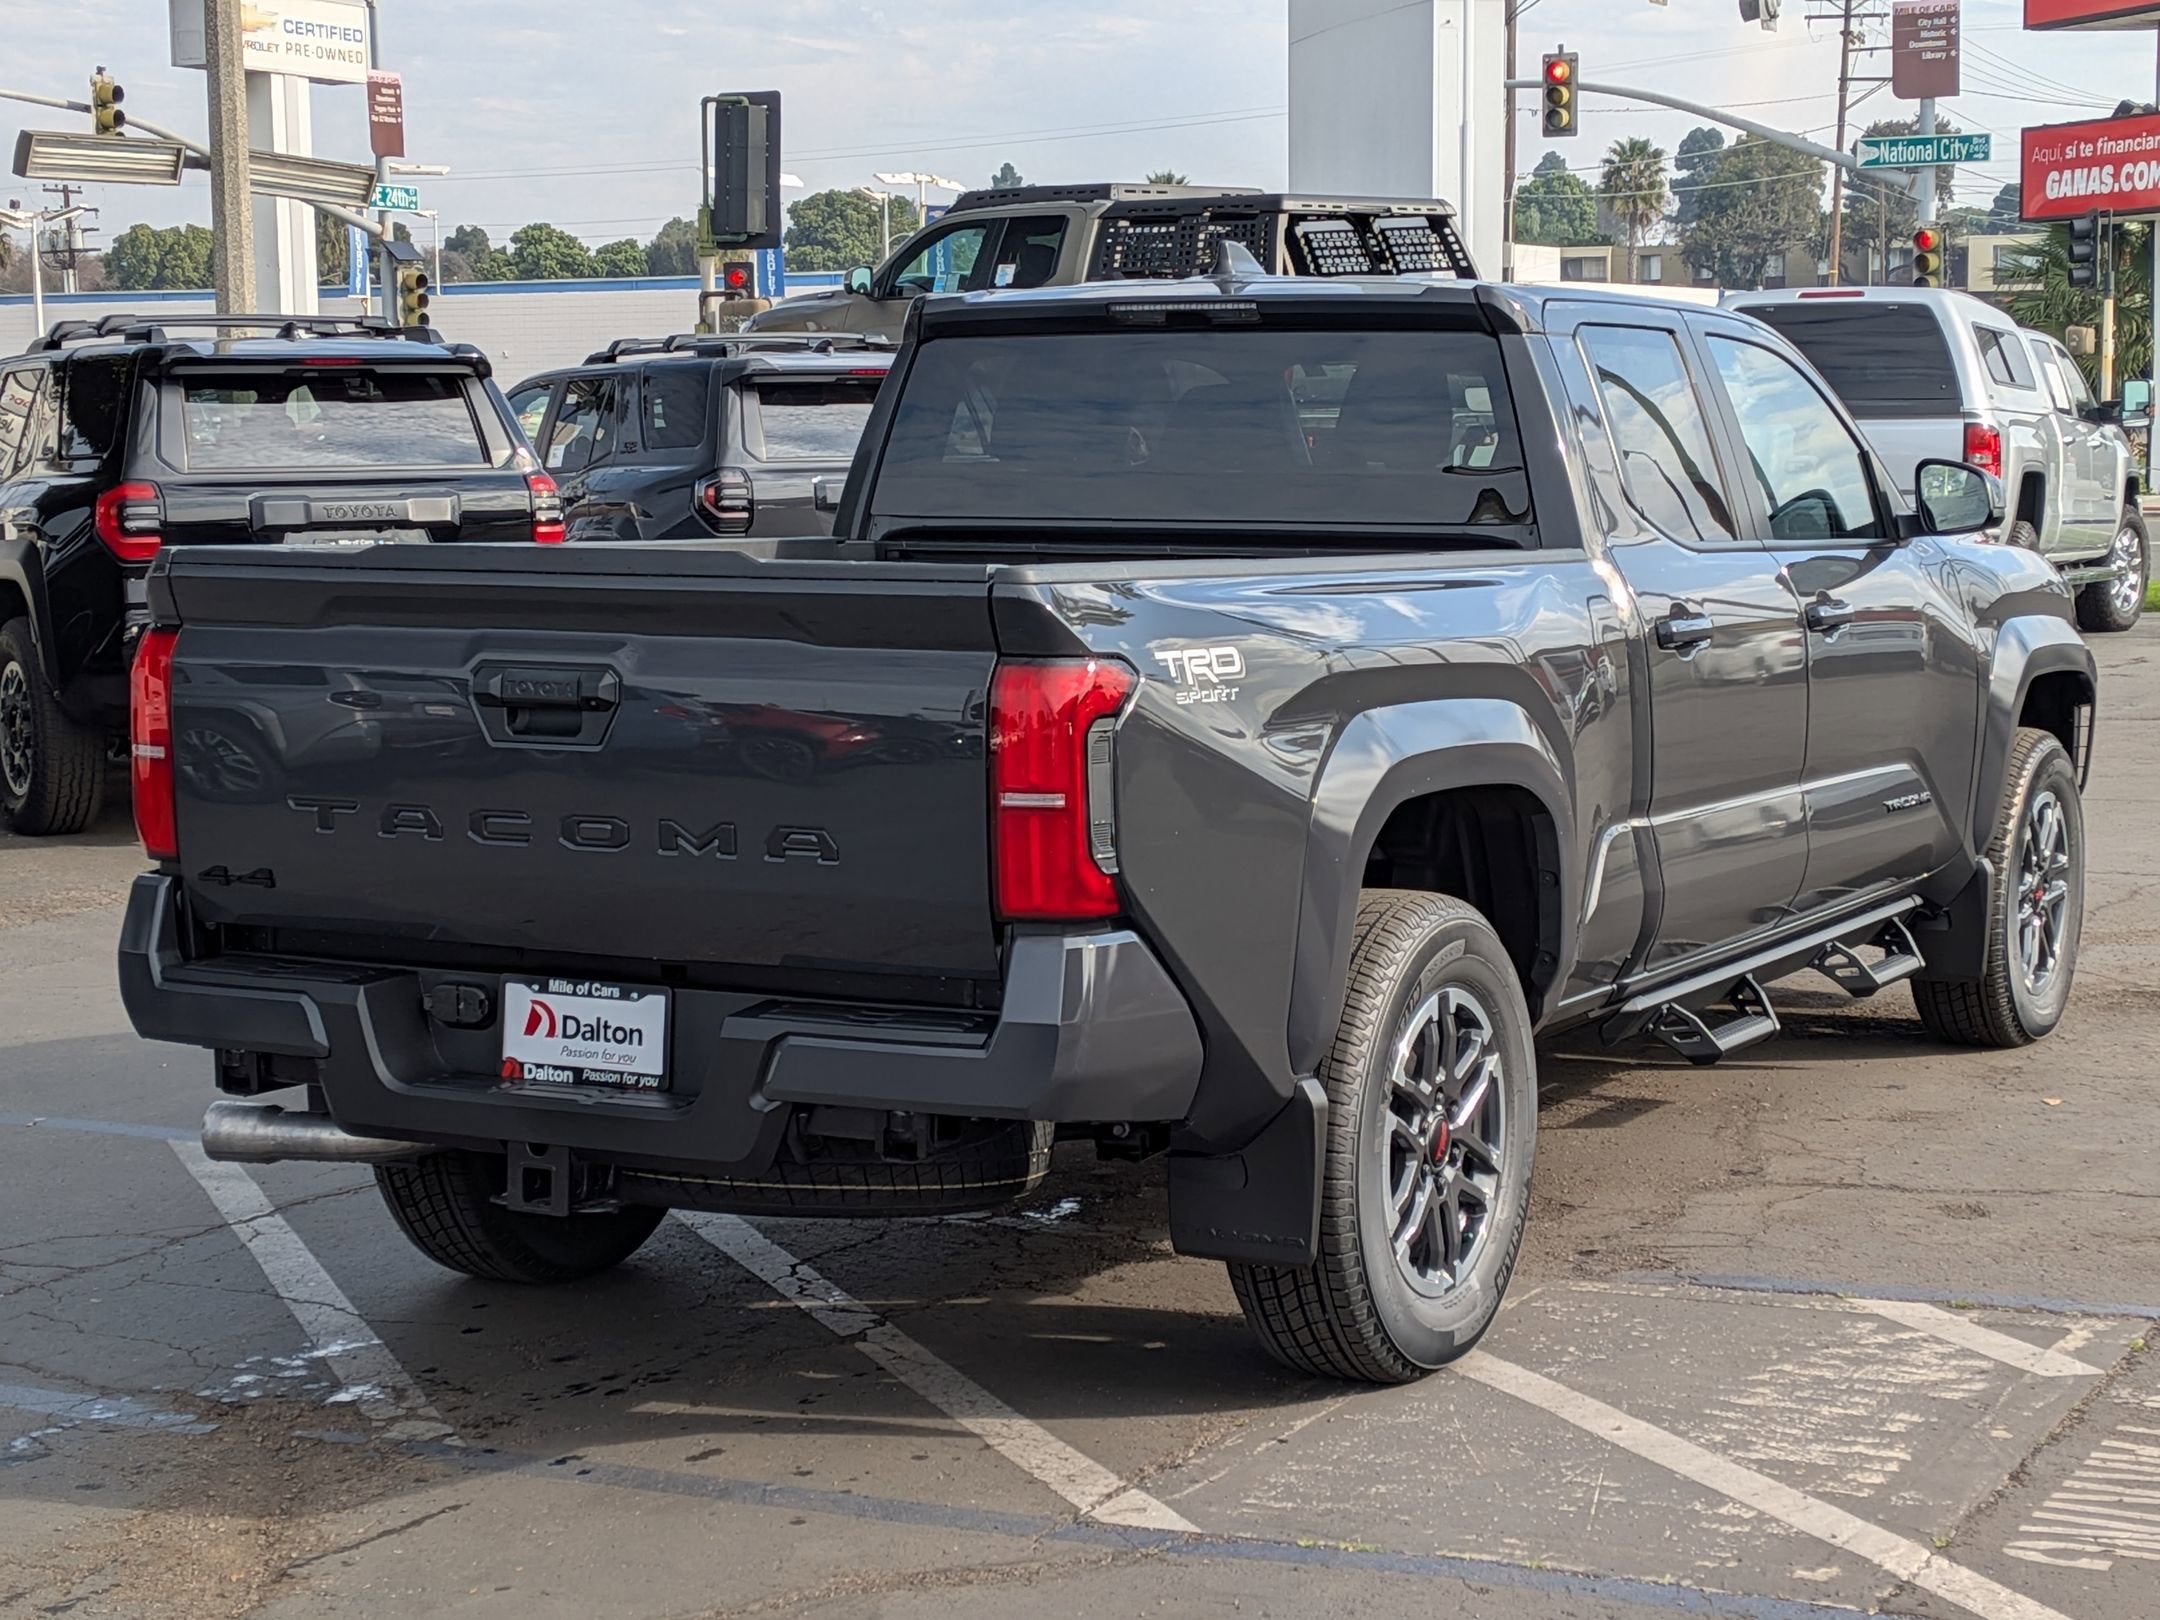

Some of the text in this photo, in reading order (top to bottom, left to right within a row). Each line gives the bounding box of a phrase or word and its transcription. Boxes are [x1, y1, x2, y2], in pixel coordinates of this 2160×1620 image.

[283, 19, 363, 43] CERTIFIED
[285, 42, 363, 64] PRE-OWNED
[1880, 138, 1969, 164] National City
[2064, 140, 2078, 159] sí
[2079, 141, 2094, 157] te
[2045, 160, 2160, 200] GANAS.COM
[375, 186, 386, 207] E
[386, 187, 409, 208] 24th
[322, 504, 398, 519] TOYOTA
[1153, 646, 1243, 686] TRD
[505, 679, 574, 698] TOYOTA
[1175, 686, 1240, 705] SPORT
[286, 794, 840, 865] TACOMA
[548, 979, 621, 998] Mile of Cars
[561, 1014, 643, 1046] Dalton
[560, 1045, 637, 1063] Passion for you
[523, 1064, 660, 1088] Dalton Passion for you
